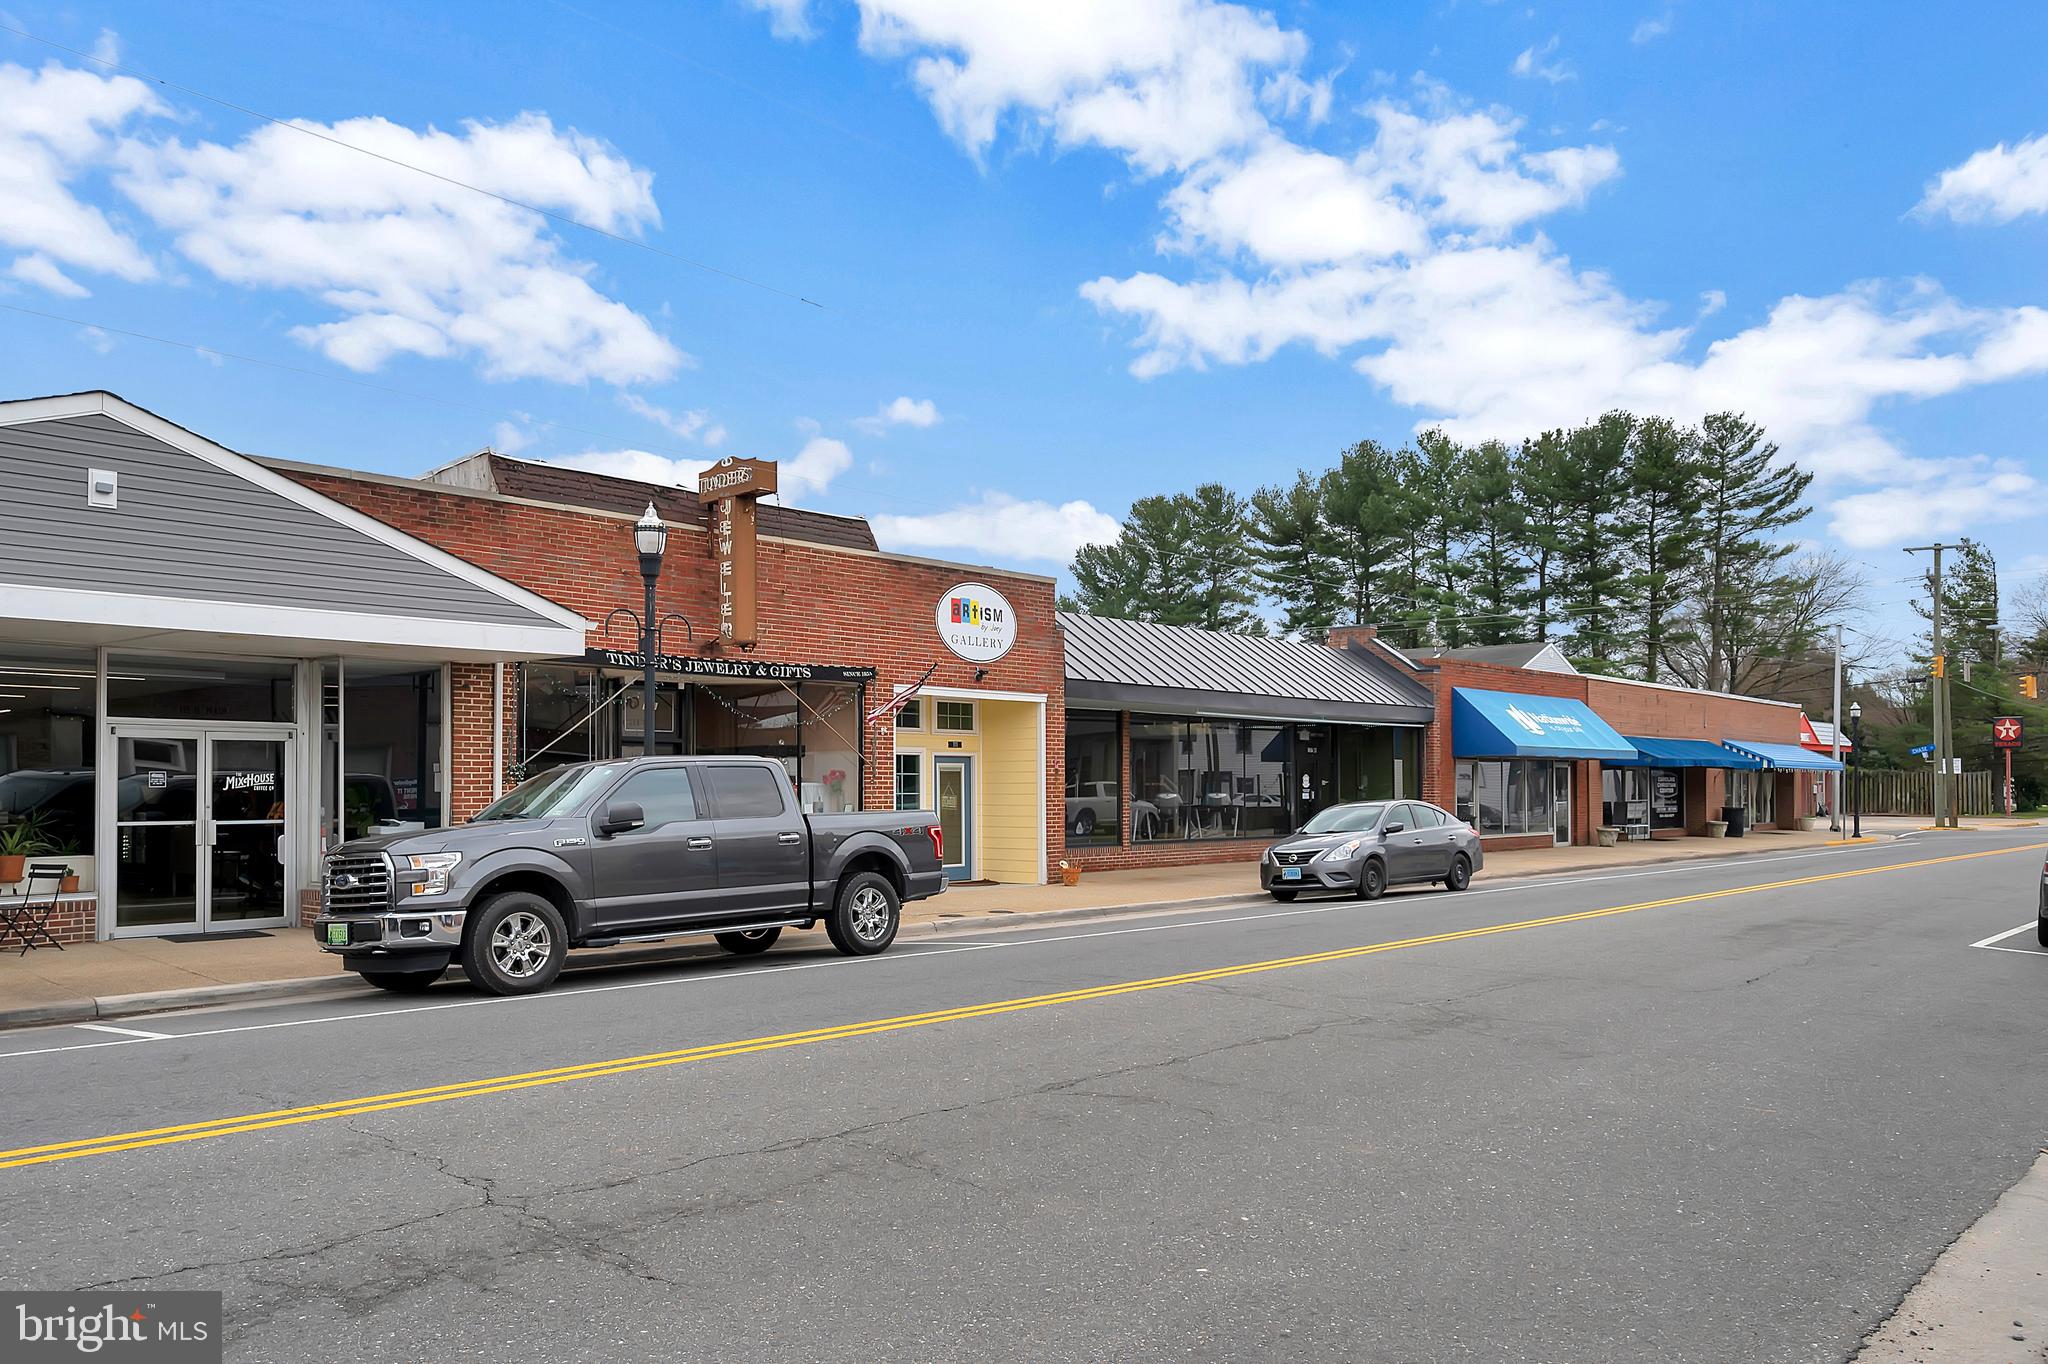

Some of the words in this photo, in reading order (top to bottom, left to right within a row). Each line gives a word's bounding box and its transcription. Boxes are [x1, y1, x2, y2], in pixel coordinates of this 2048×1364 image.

[951, 634, 1003, 649] GALLERY
[685, 660, 752, 676] JEWELRY
[756, 665, 767, 676] &
[770, 665, 812, 678] GIFTS
